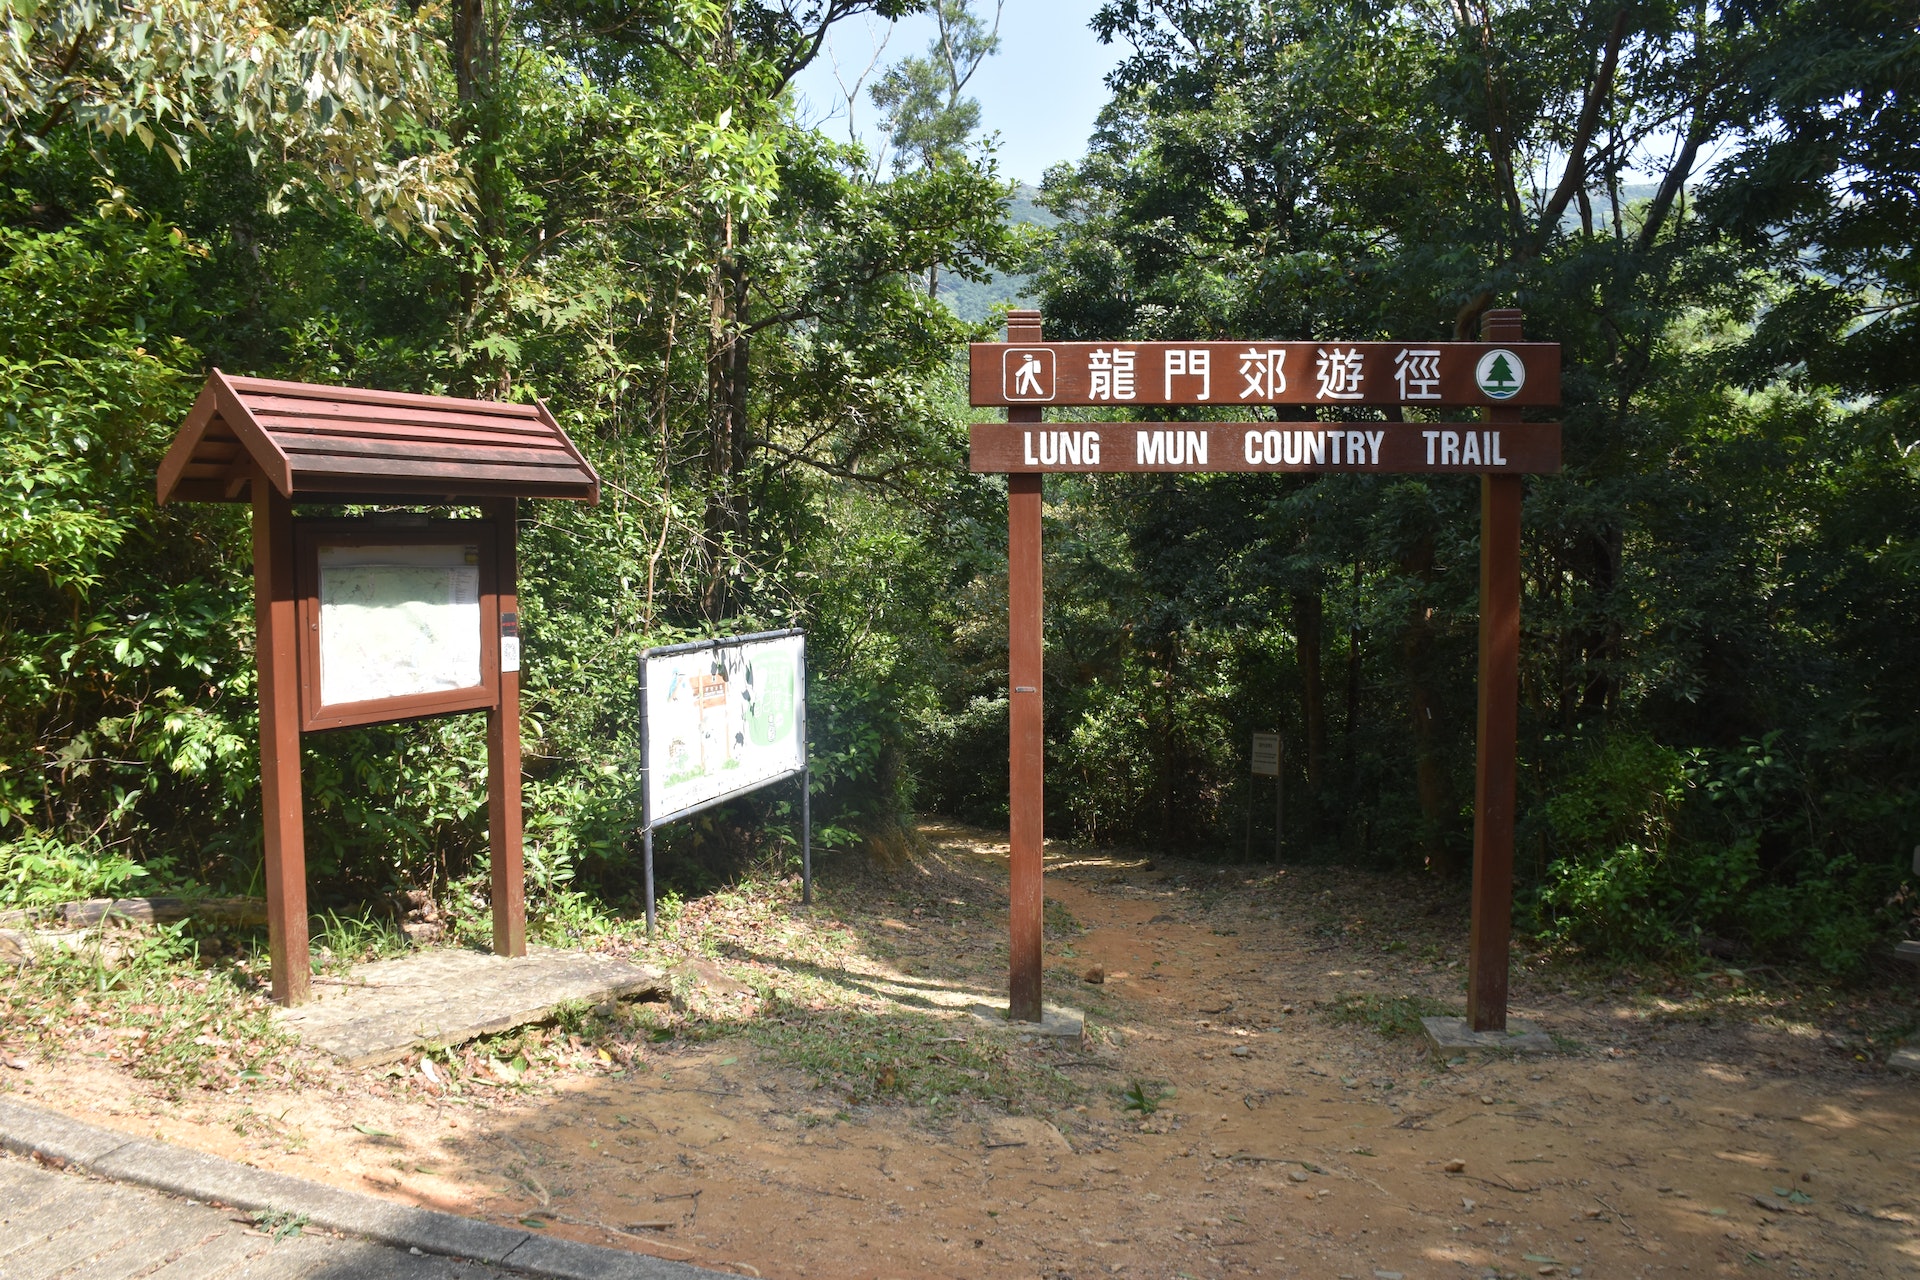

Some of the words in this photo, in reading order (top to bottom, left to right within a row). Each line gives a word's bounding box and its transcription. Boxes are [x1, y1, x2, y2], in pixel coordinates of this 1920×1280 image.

[1088, 347, 1442, 401] 龍門郊遊徑
[1024, 431, 1100, 465] LUNG
[1137, 431, 1208, 465] MUN
[1244, 430, 1384, 465] COUNTRY
[1422, 430, 1507, 466] TRAIL
